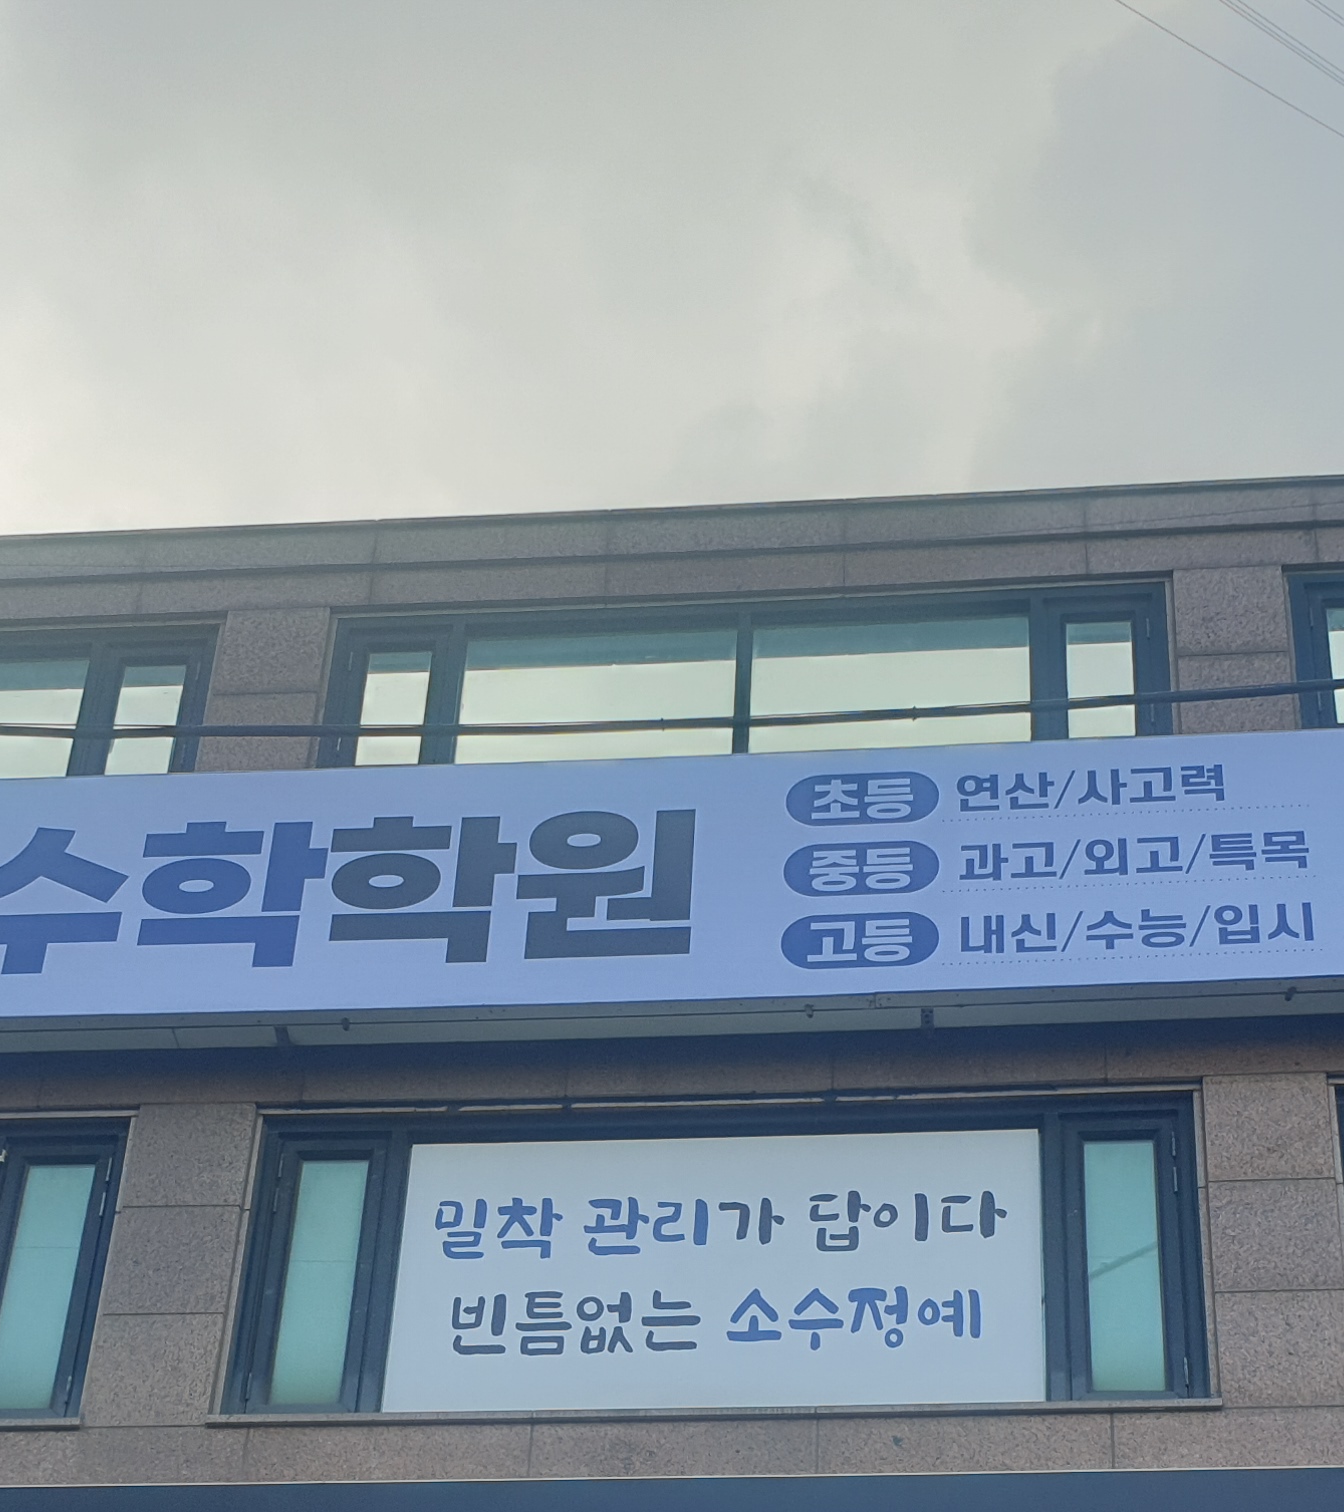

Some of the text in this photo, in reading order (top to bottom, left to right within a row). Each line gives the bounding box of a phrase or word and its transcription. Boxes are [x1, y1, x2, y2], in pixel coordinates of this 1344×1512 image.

[809, 763, 1226, 820] 초등 연산/사고력
[809, 830, 1311, 891] 중등 과고/외고/특목
[806, 902, 1316, 963] 고등 내신/수능/입시
[434, 1190, 1008, 1260] 밀착 관리가 답이다
[451, 1284, 983, 1357] 빈틈없는 소수정예
